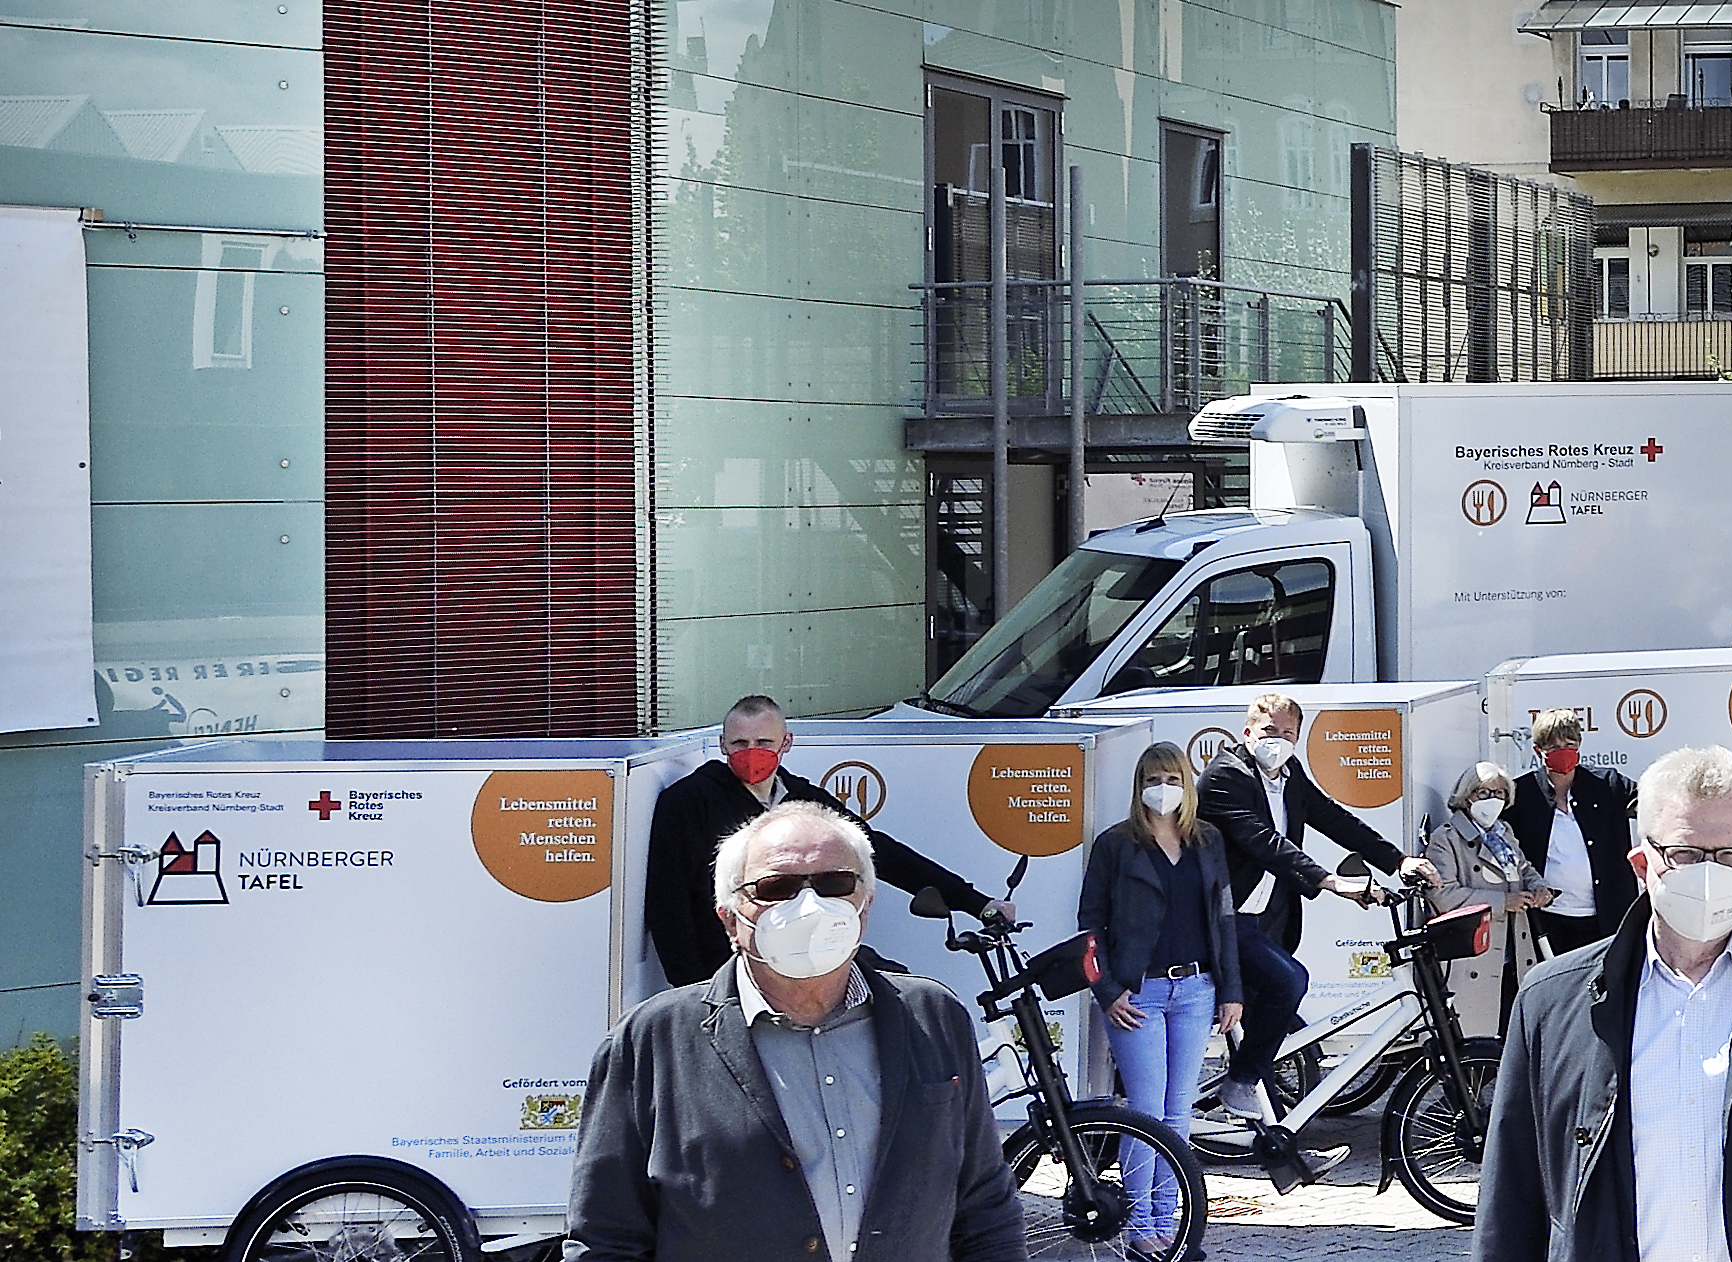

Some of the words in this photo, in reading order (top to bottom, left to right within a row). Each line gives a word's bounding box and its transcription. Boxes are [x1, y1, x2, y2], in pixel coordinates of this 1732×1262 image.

[1455, 445, 1544, 461] Bayerisches
[1549, 444, 1589, 457] Rotes
[1593, 443, 1634, 456] Kreuz
[1483, 460, 1549, 471] Kreisverband
[1553, 459, 1598, 470] Nürnberg
[1608, 458, 1634, 468] Stadt
[1570, 490, 1648, 501] NÜRNBERGER
[1570, 505, 1603, 515] TAFEL
[1454, 592, 1470, 602] Mit
[1474, 589, 1543, 602] Unterstützung
[1325, 730, 1391, 741] Lebensmittel
[1358, 745, 1392, 753] retten.
[1340, 756, 1392, 767] Menschen
[991, 767, 1072, 778] Lebensmittel
[1357, 769, 1392, 779] helfen.
[1031, 783, 1071, 793] retten.
[149, 791, 203, 800] Bayerisches
[206, 791, 232, 799] Rotes
[235, 791, 261, 799] Kreuz
[349, 790, 423, 801] Bayerisches
[149, 803, 209, 812] Kreisverband
[349, 801, 384, 810] Rotes
[500, 797, 597, 811] Lebensmittel
[1008, 796, 1070, 808] Menschen
[349, 811, 383, 821] Kreuz
[1029, 811, 1070, 823] helfen.
[548, 816, 596, 828] retten.
[520, 832, 596, 845] Menschen
[239, 848, 394, 867] NÜRNBERGER
[545, 849, 595, 862] helfen.
[238, 874, 303, 890] TAFEL
[502, 1078, 558, 1089] Gefördert
[562, 1079, 587, 1088] vom
[392, 1136, 459, 1148] Bayerisches
[462, 1135, 565, 1146] Staatsministerium
[476, 1147, 510, 1157] Arbeit
[514, 1147, 535, 1157] und
